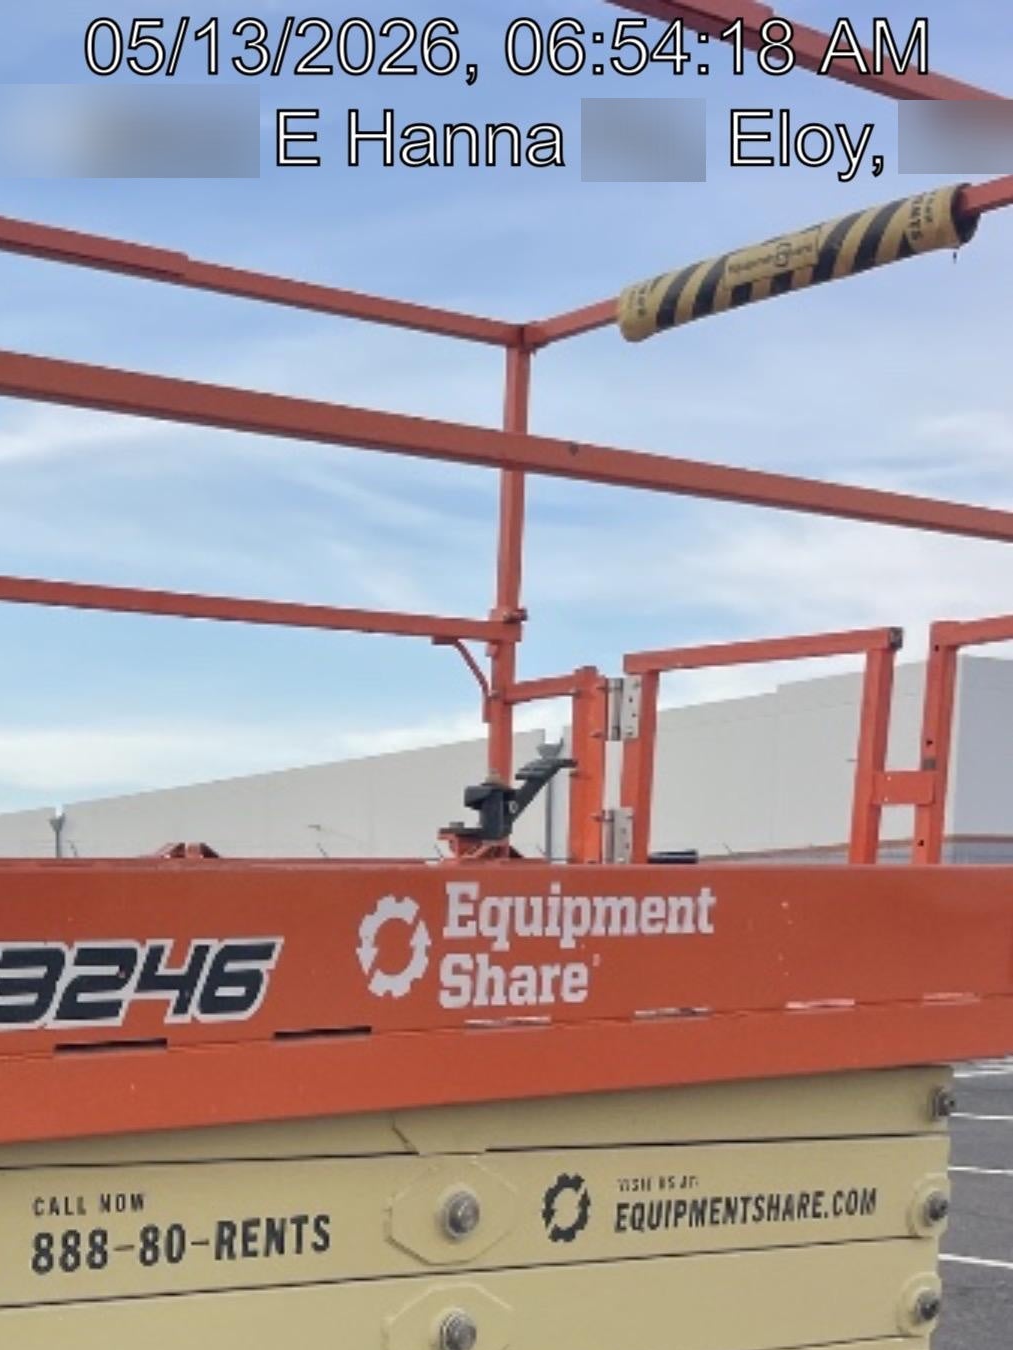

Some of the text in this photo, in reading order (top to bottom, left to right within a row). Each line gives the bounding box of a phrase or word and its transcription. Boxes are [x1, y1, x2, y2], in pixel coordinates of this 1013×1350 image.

[443, 881, 716, 951] Equipment
[439, 952, 589, 1009] Share
[31, 1192, 146, 1216] CALL NOW
[613, 1187, 878, 1233] EQUIPMENTSHARE.COM
[31, 1214, 331, 1275] 888-80-RENTS
